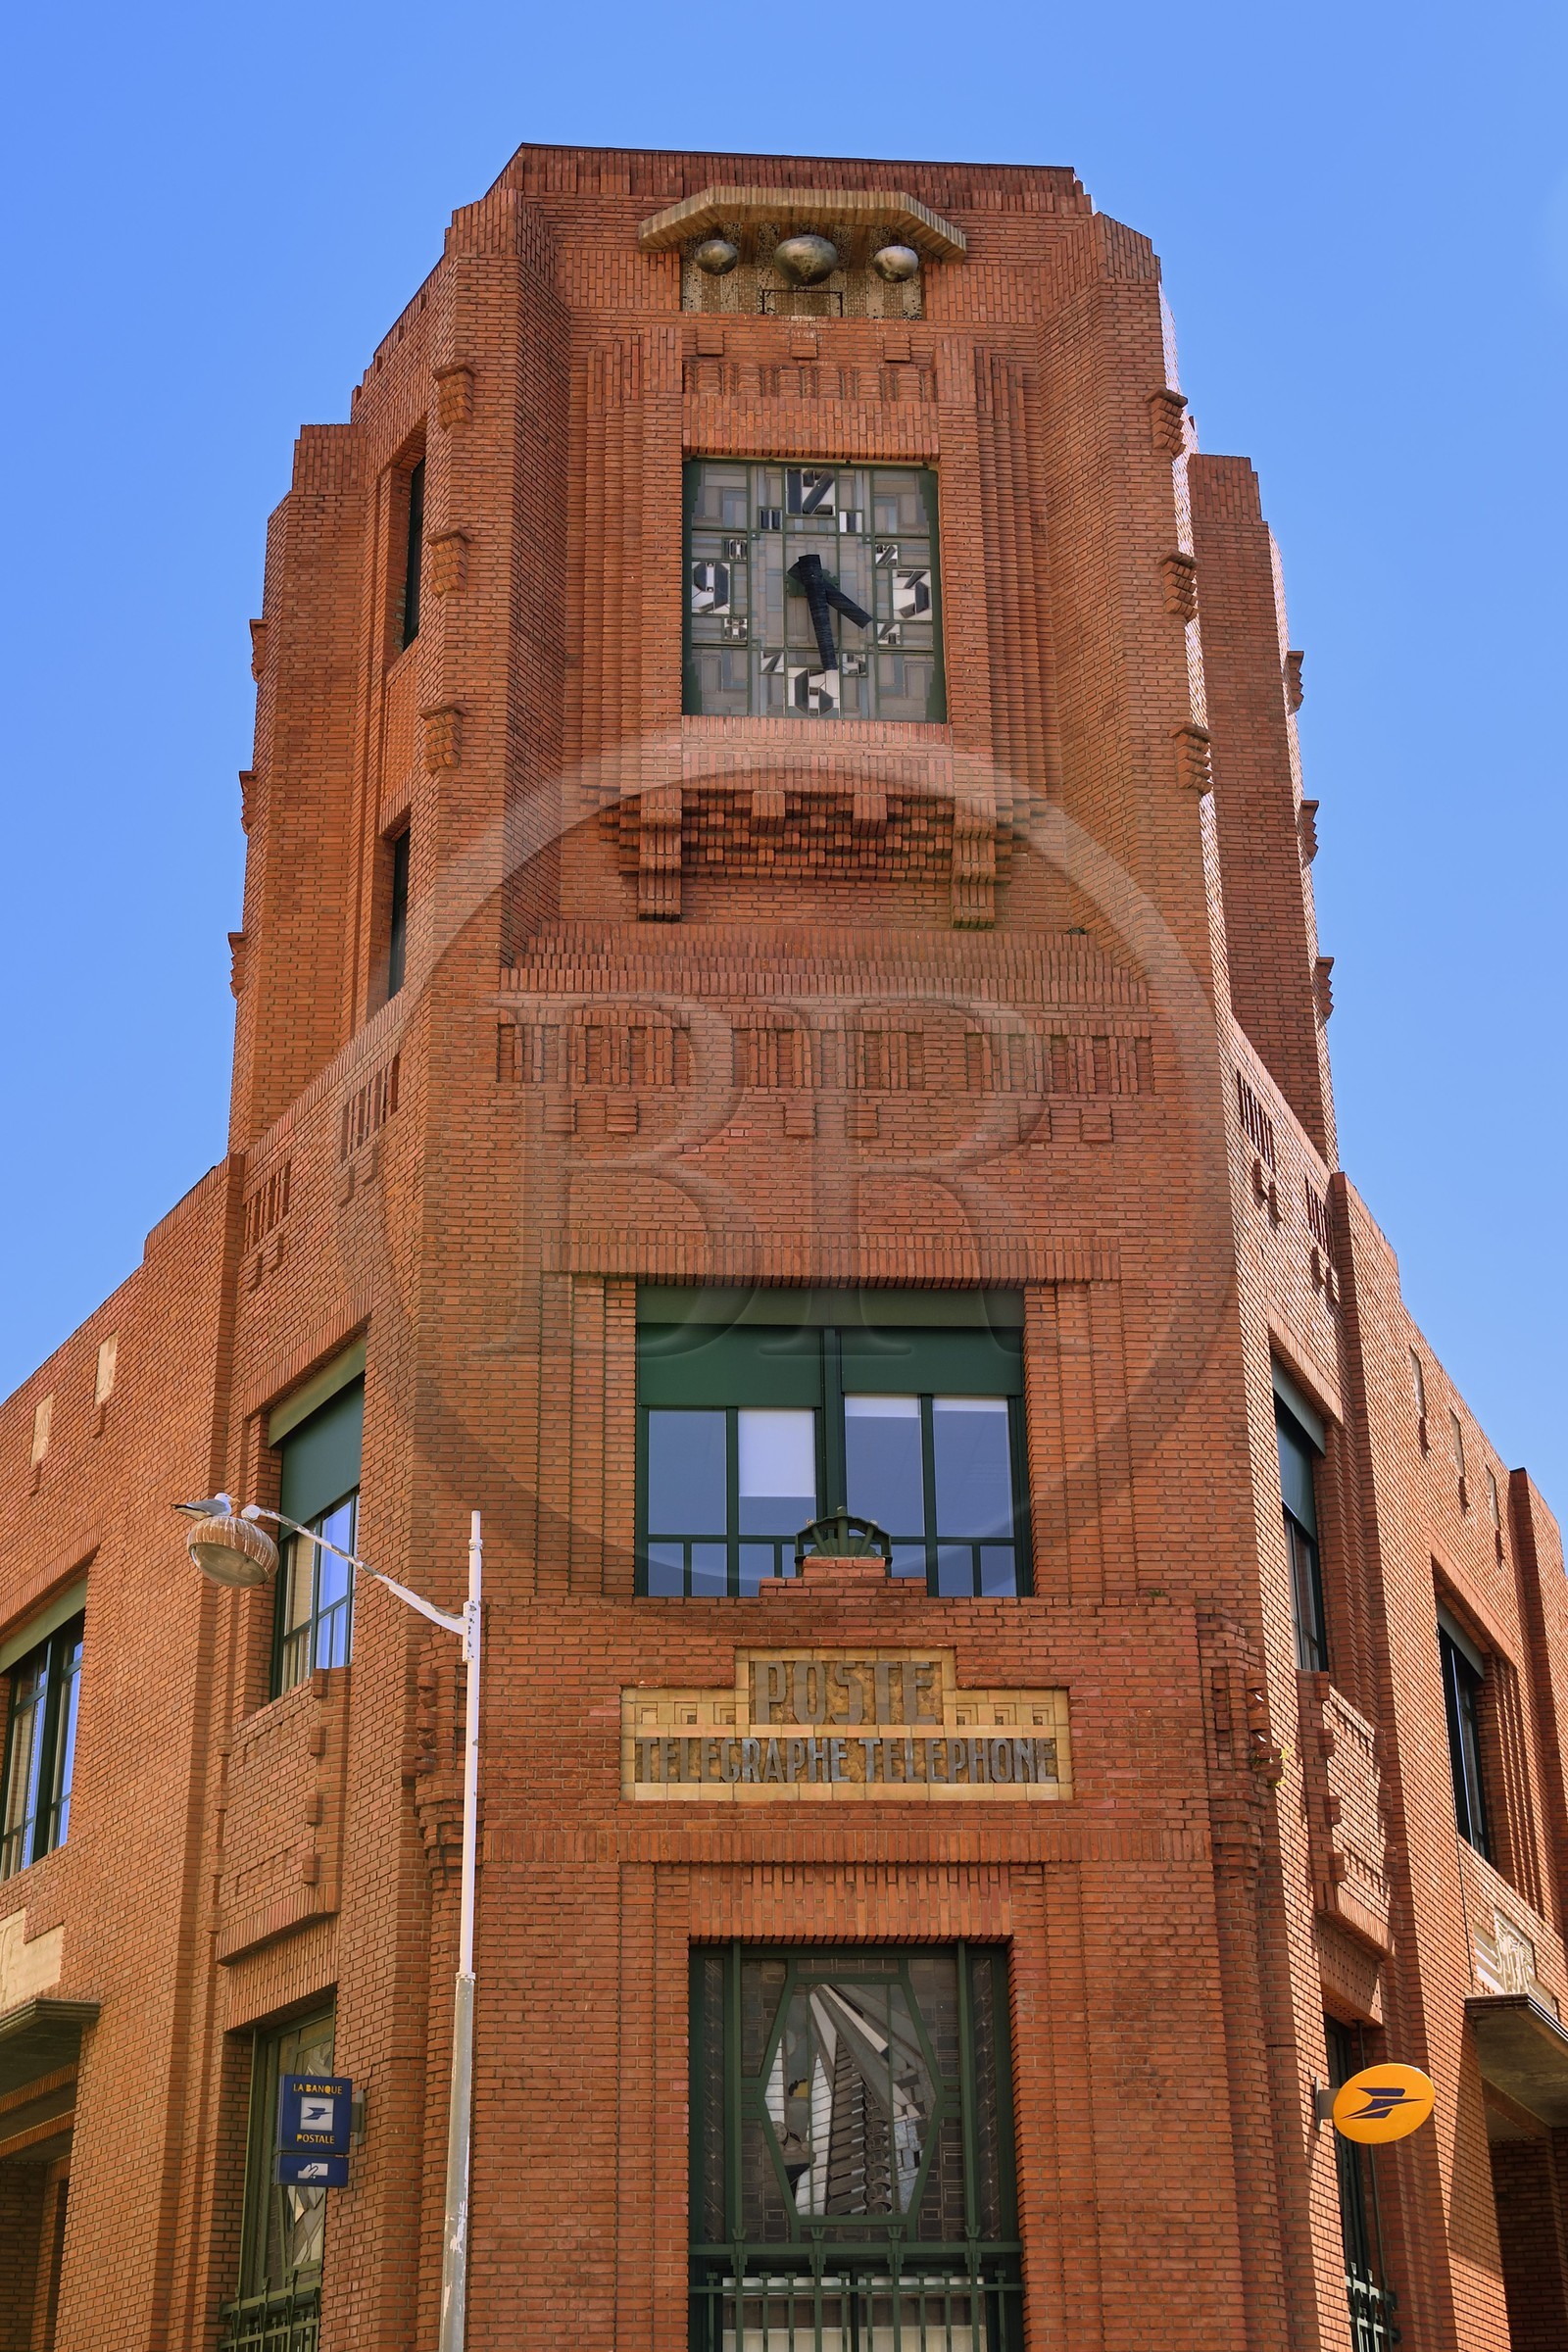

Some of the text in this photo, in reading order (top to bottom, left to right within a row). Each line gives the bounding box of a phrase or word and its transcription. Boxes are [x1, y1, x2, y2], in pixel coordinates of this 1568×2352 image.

[786, 468, 835, 515] 12
[693, 562, 730, 613] 9
[896, 569, 930, 619] 3
[794, 668, 834, 716] 6
[754, 1660, 938, 1725] POSTE
[635, 1737, 1058, 1784] TELEGRAPHE TELEPHONE
[306, 2084, 342, 2094] BANQUE
[297, 2134, 334, 2143] POSTALE
